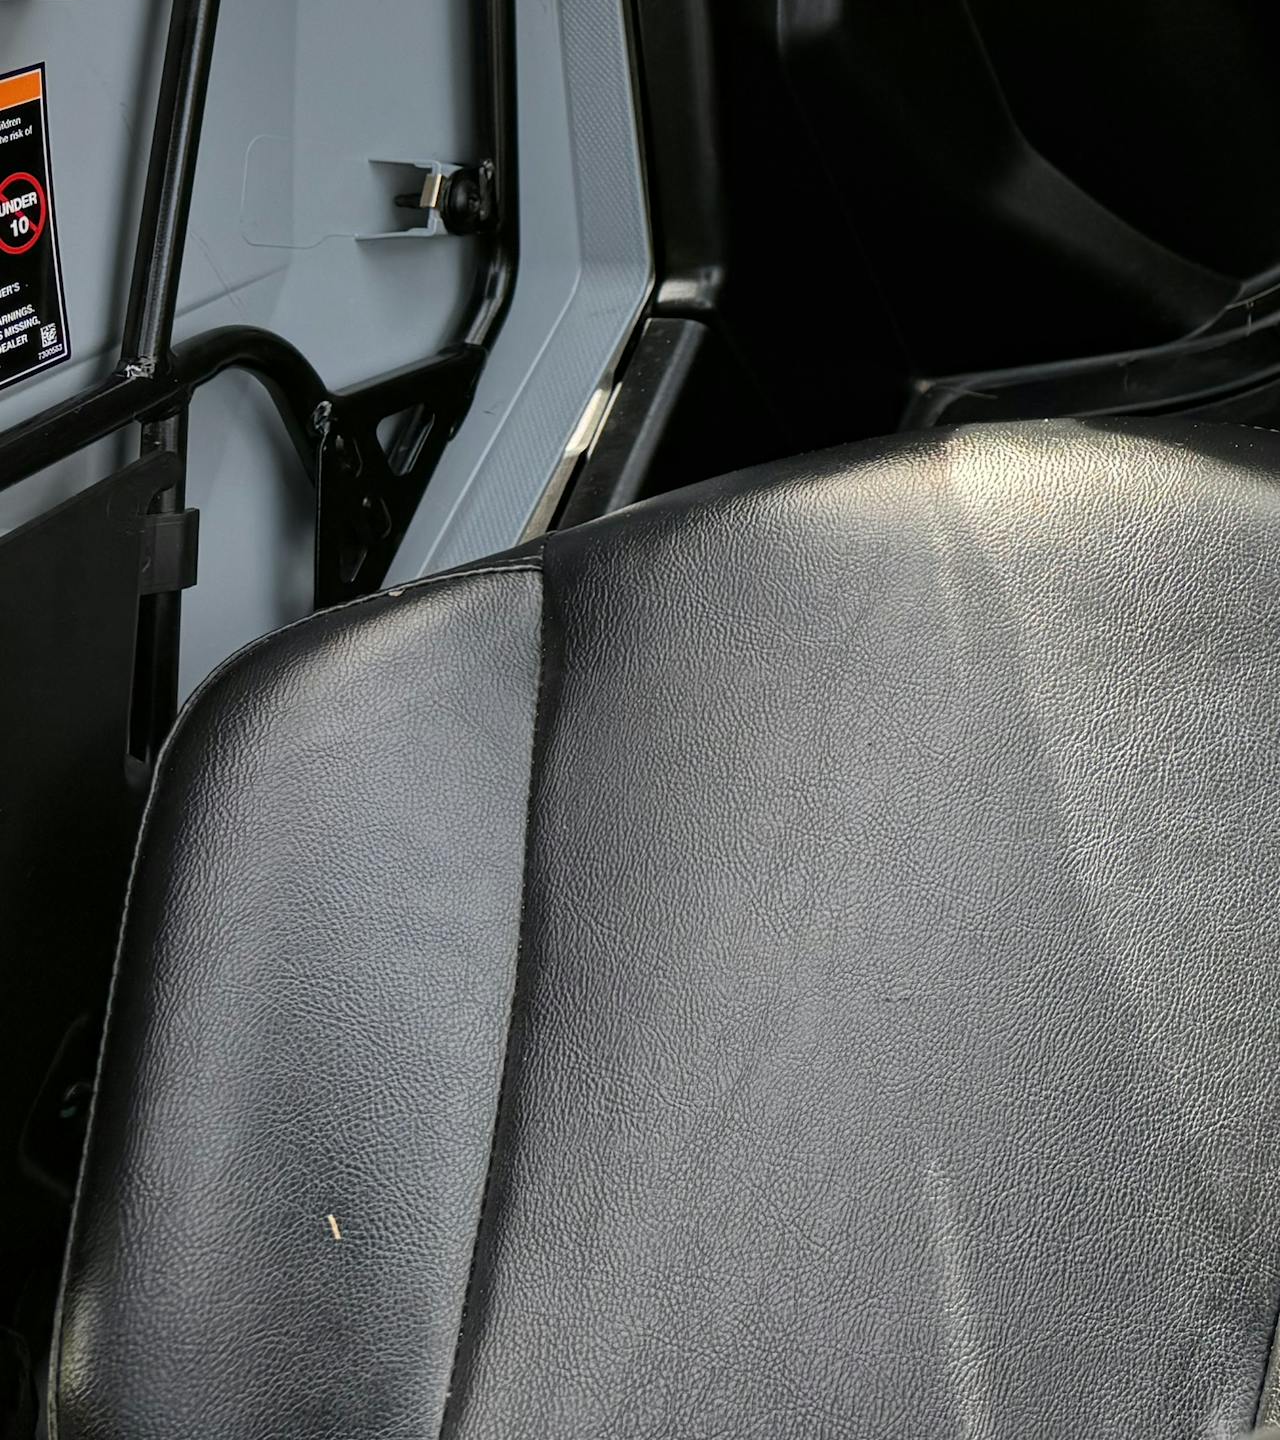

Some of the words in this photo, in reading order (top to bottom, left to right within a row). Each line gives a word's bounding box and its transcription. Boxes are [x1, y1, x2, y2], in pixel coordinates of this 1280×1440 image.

[10, 128, 24, 141] risk
[24, 124, 33, 136] of
[0, 192, 38, 217] UNDER
[10, 215, 30, 237] 10
[4, 316, 41, 338] MISSING,
